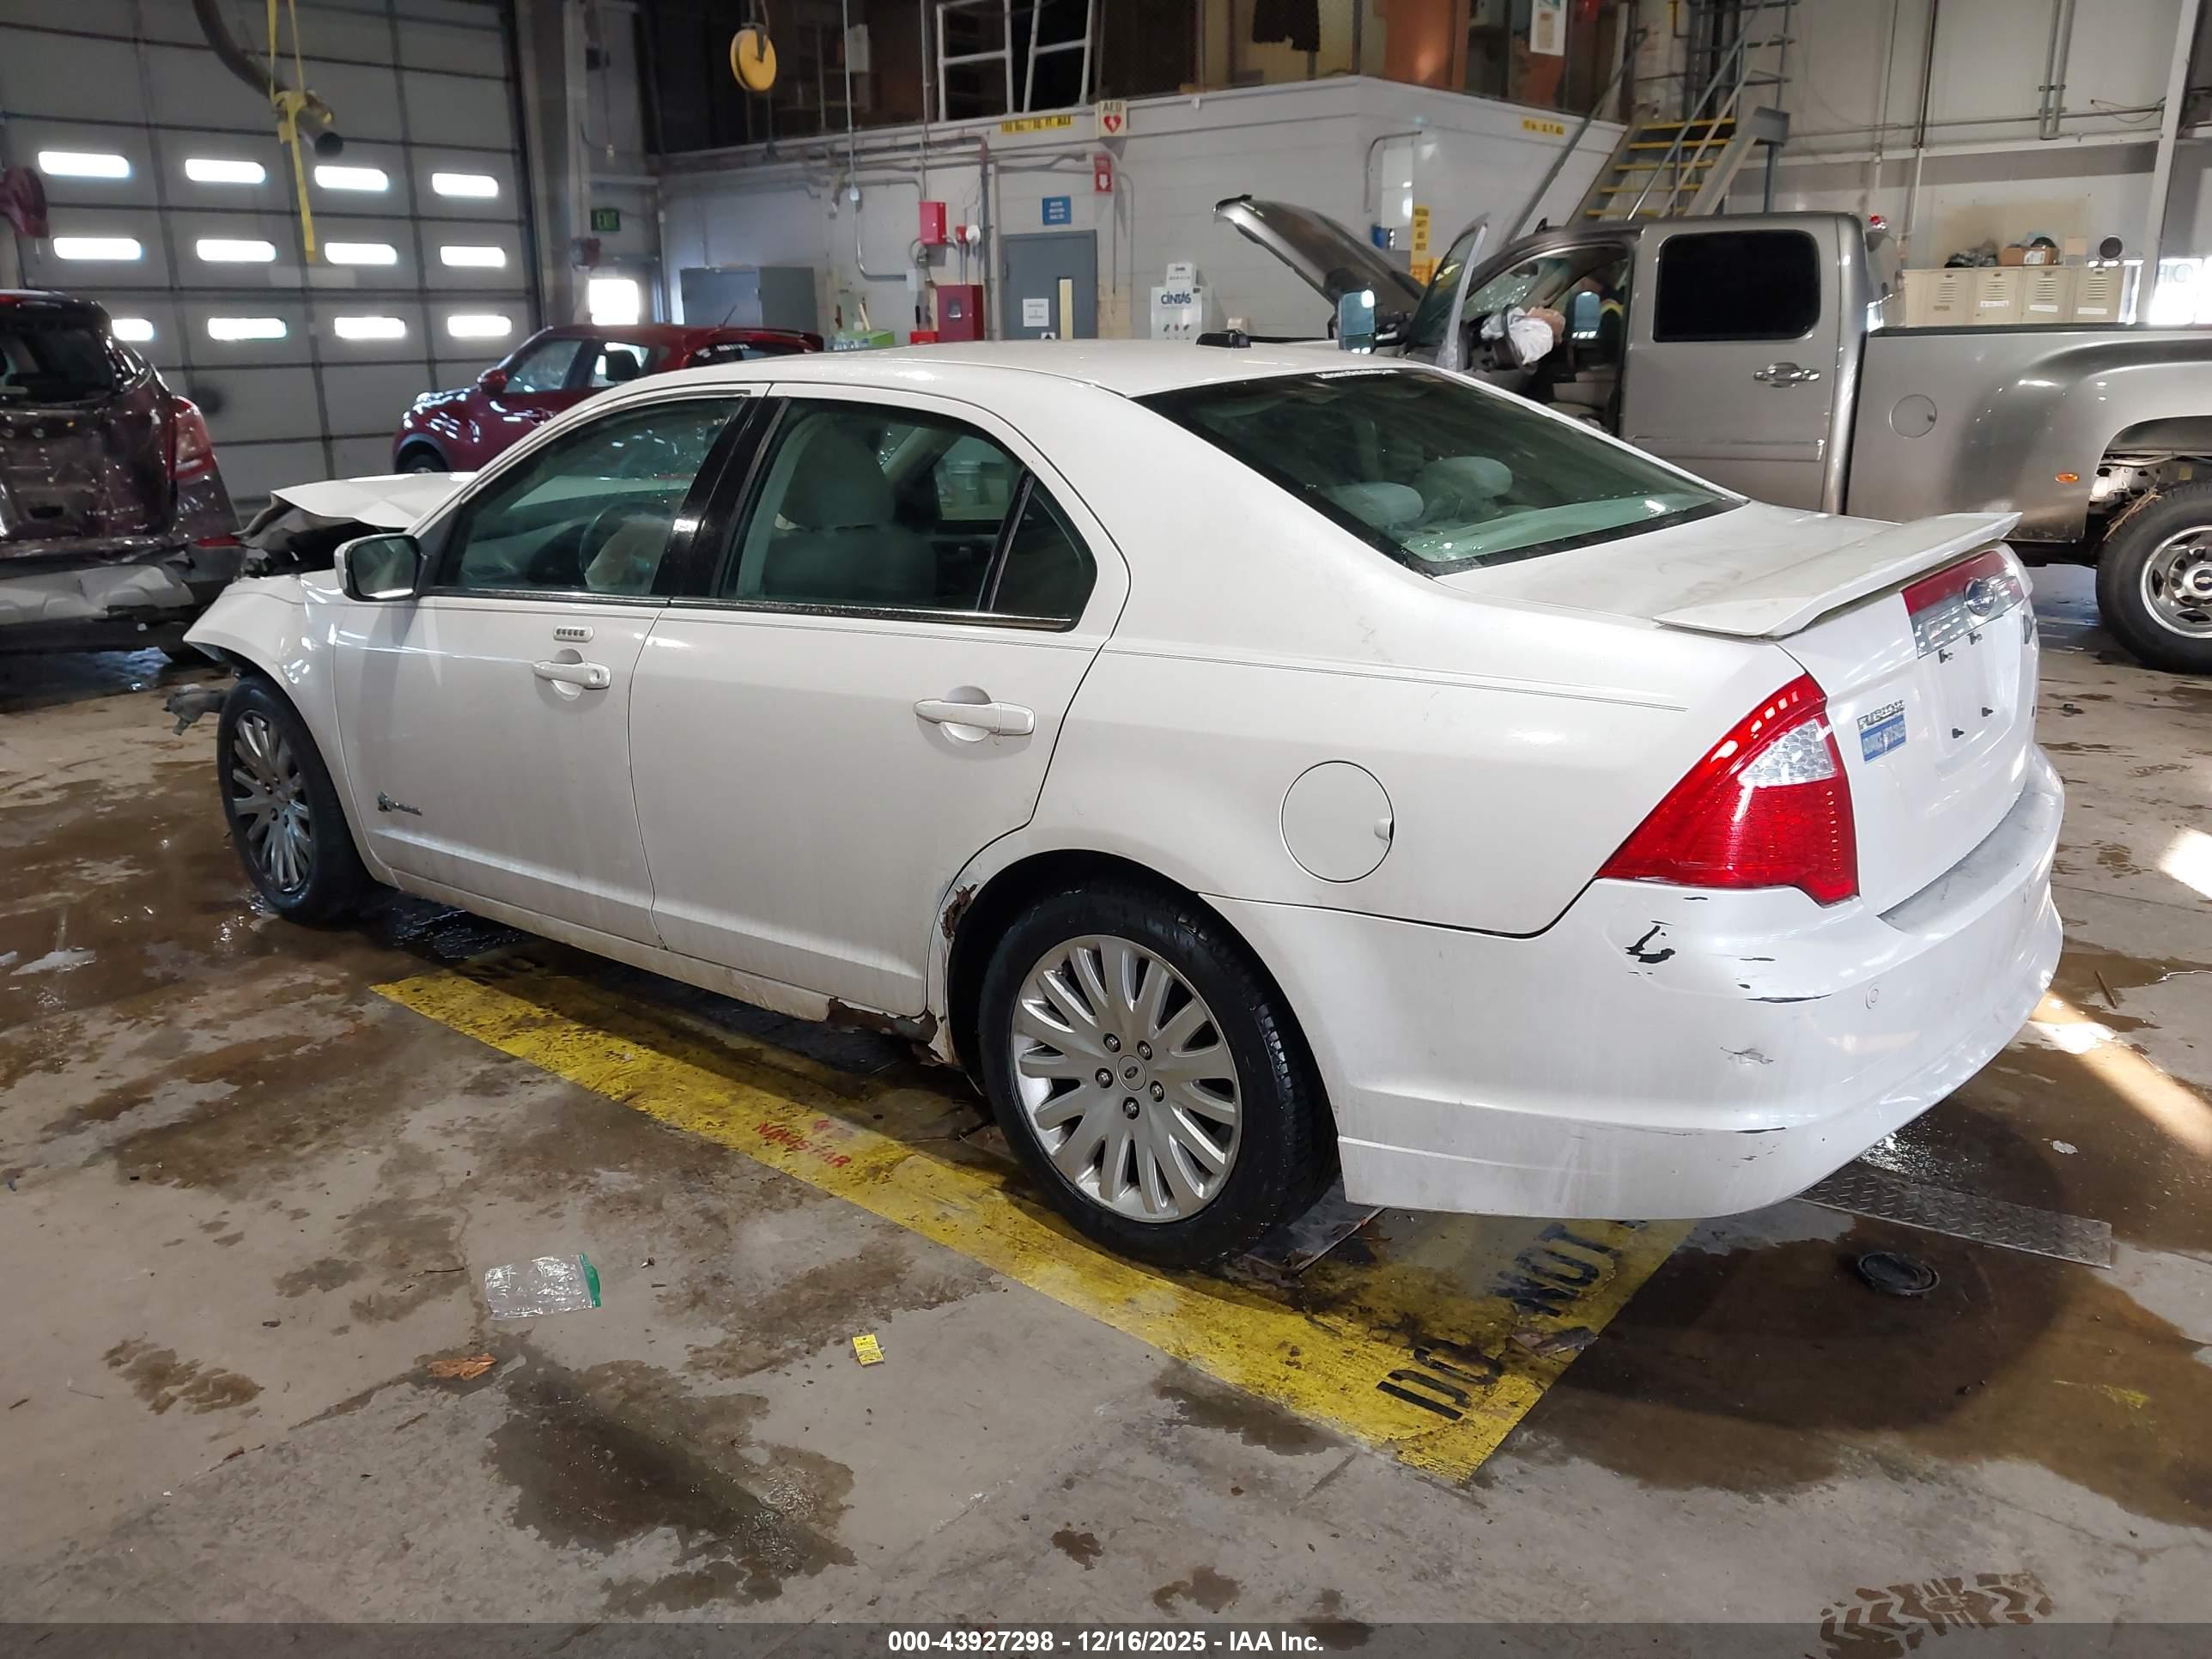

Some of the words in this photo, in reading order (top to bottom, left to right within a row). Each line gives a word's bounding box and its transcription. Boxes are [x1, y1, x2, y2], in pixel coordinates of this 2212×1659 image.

[1103, 102, 1122, 112] AED
[1160, 291, 1192, 305] CINTAS
[1492, 1222, 1621, 1318] NOT
